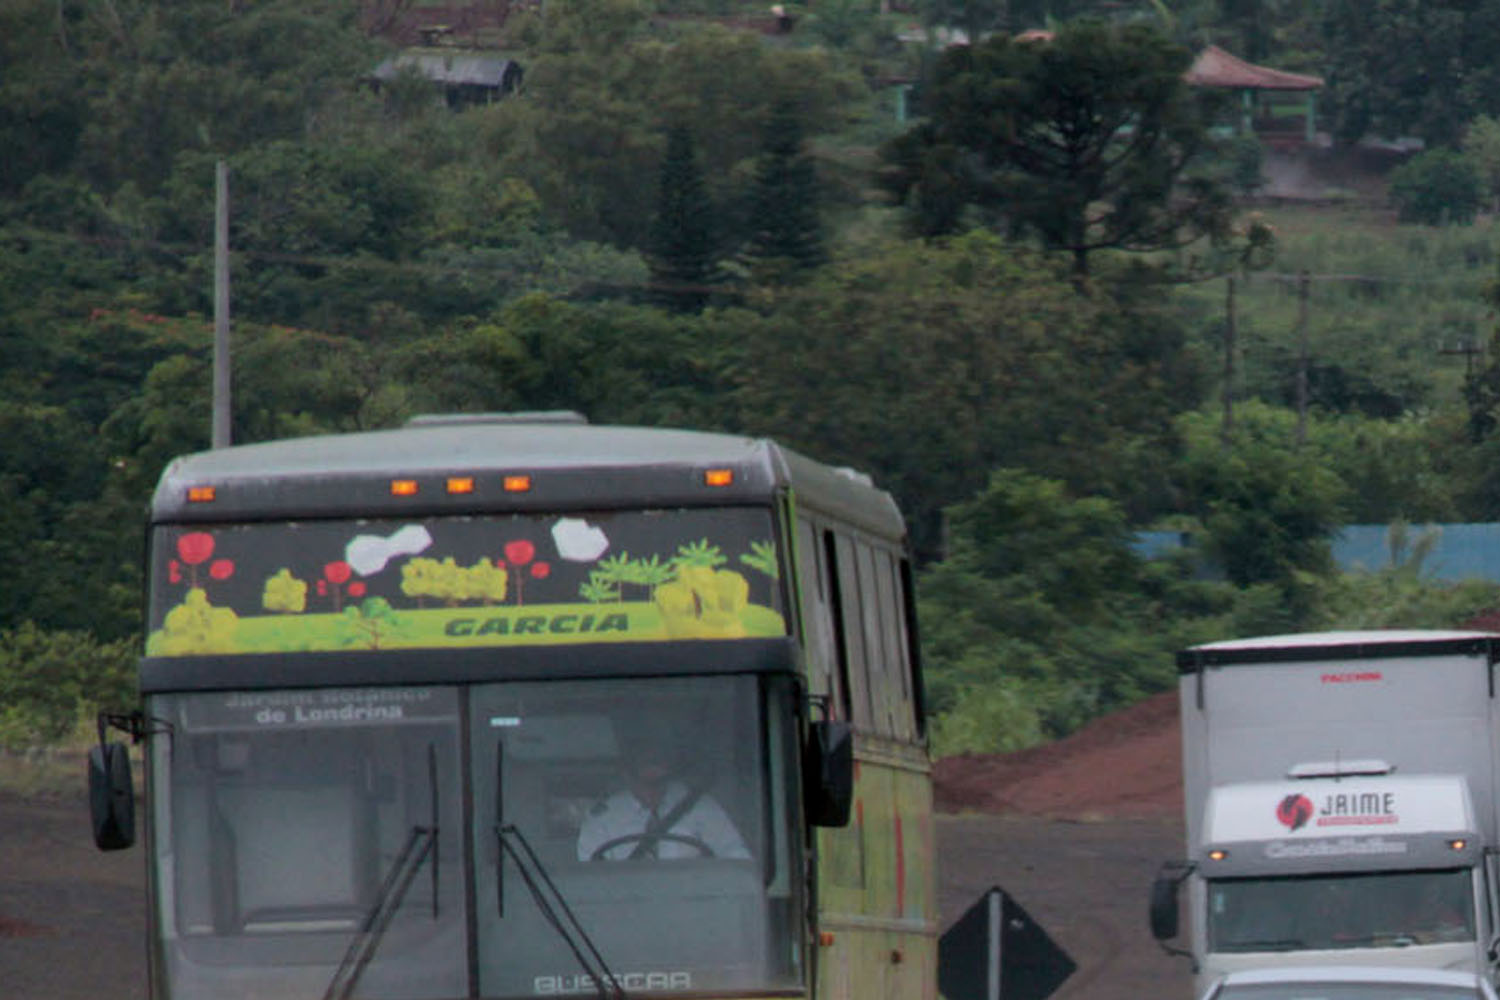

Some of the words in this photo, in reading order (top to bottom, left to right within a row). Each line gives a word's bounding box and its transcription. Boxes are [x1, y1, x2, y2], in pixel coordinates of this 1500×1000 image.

[445, 613, 629, 636] GARCIA
[255, 708, 287, 724] de
[294, 704, 403, 721] Londrina
[1319, 793, 1395, 815] JAIME
